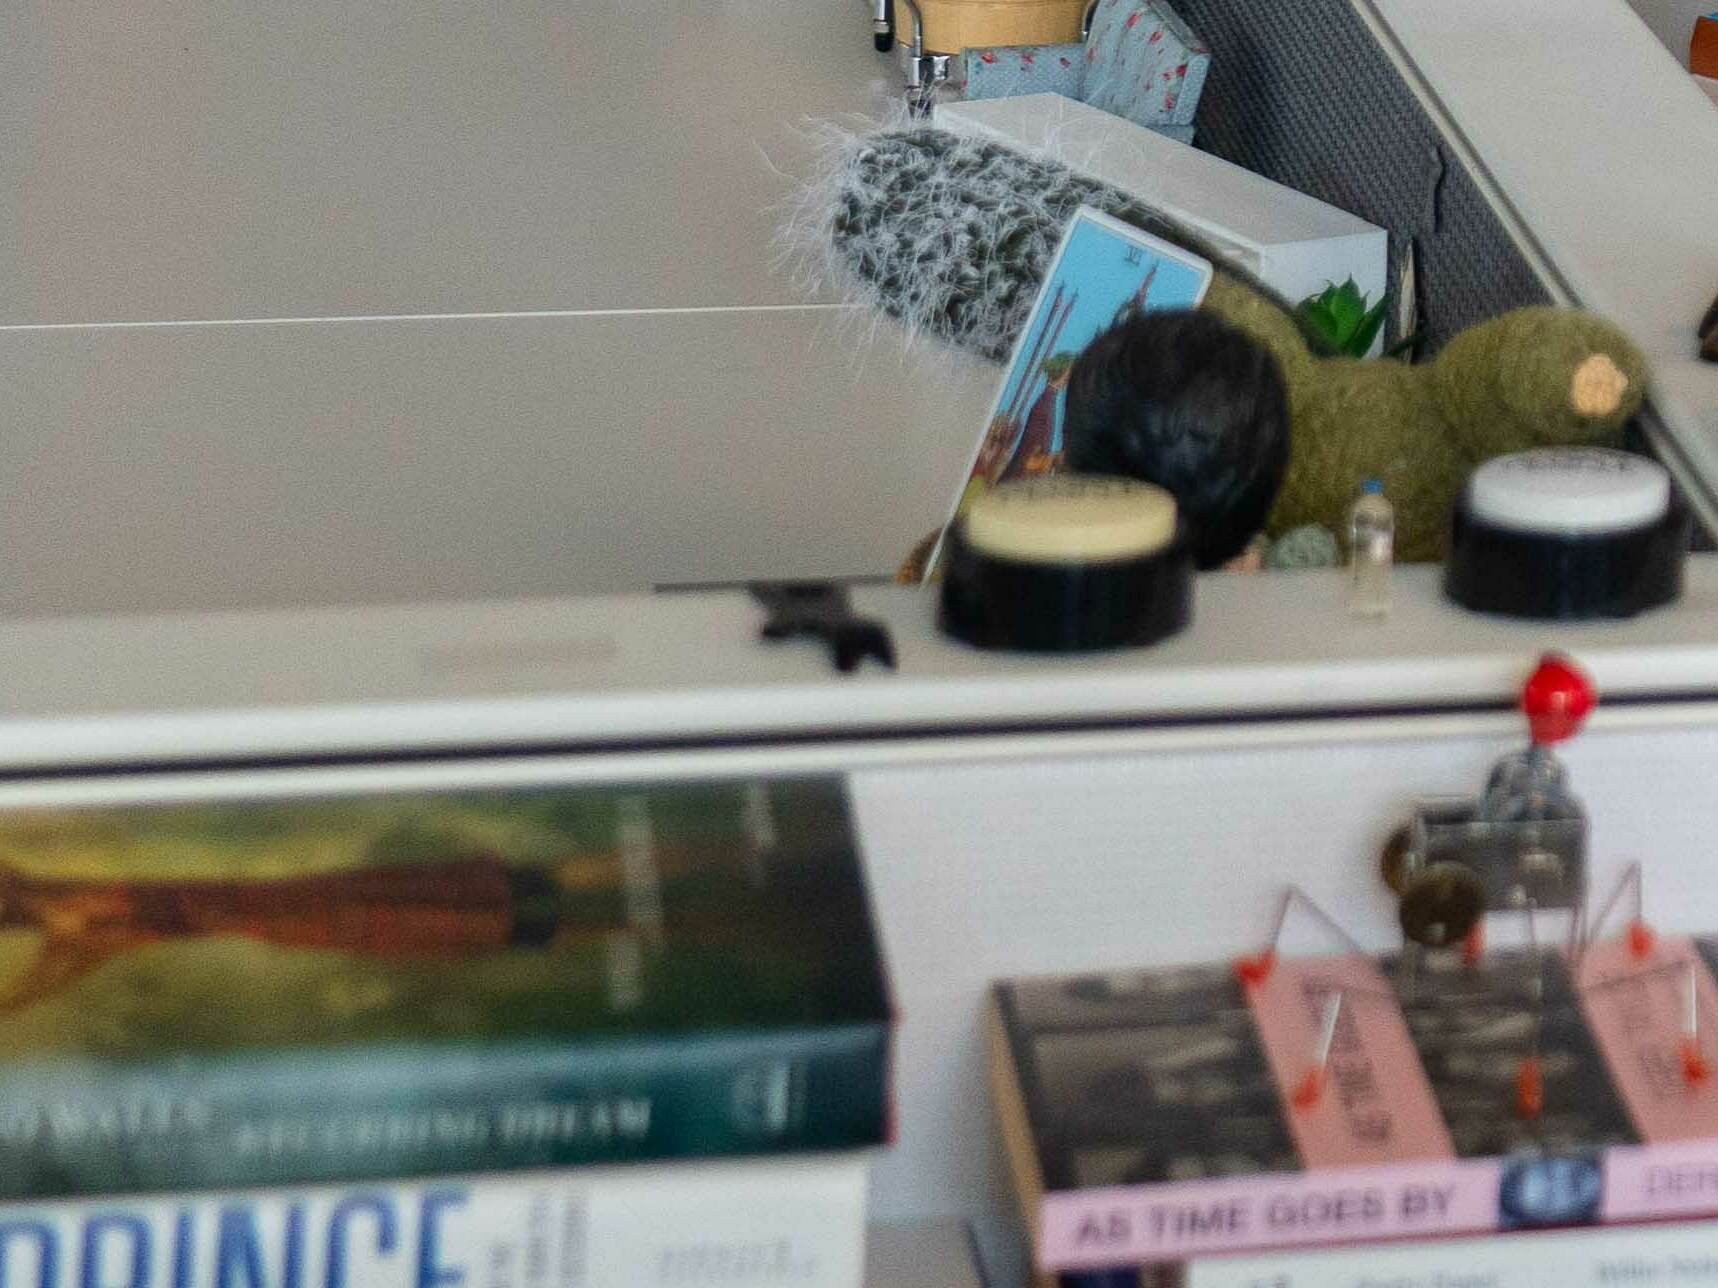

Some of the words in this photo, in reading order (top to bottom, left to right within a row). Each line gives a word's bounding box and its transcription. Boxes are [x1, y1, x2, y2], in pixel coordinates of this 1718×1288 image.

[1075, 1212, 1132, 1246] AS
[1151, 1202, 1240, 1243] TIME
[1267, 1190, 1383, 1234] GOES
[1400, 1184, 1454, 1220] BY
